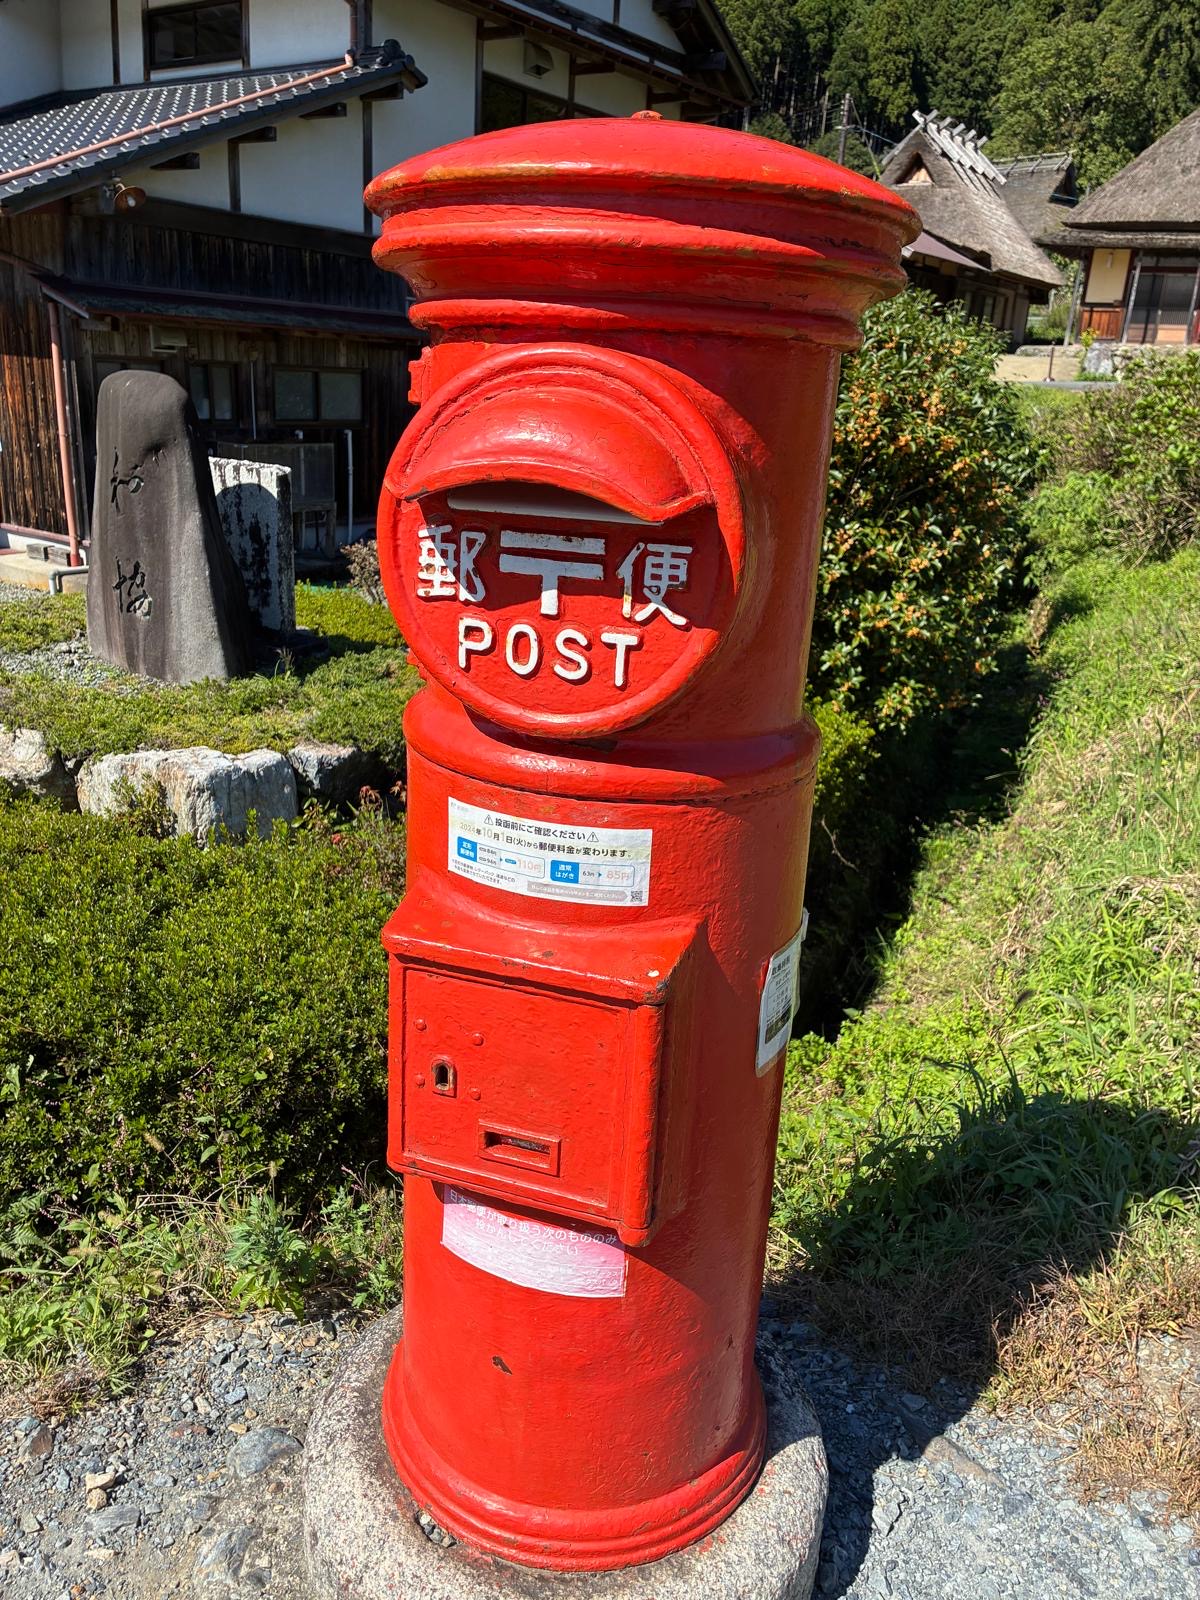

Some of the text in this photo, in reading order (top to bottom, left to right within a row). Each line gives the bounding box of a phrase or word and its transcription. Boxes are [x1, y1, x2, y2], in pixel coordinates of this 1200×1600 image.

[458, 616, 641, 687] POST
[495, 817, 586, 841] 投函前にご確認ください
[555, 871, 575, 880] はがき
[606, 870, 630, 881] 85円
